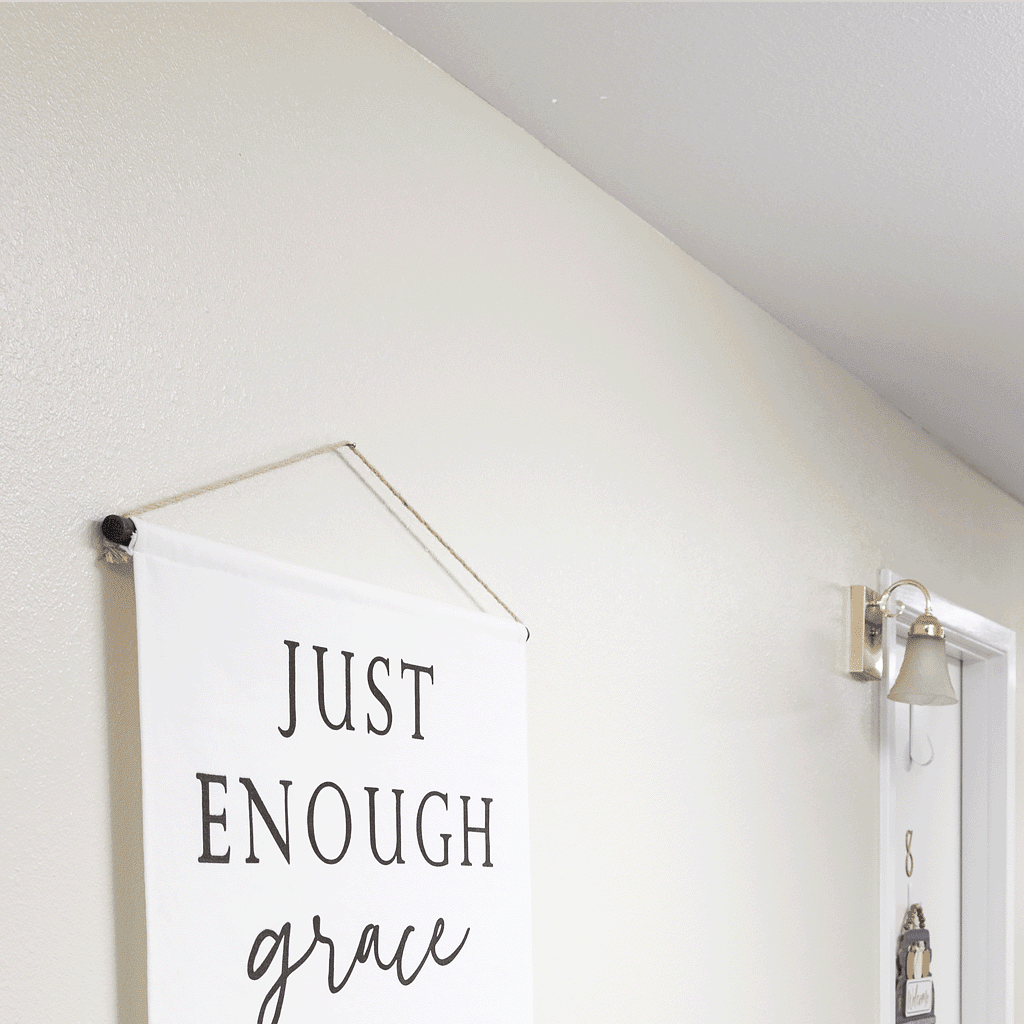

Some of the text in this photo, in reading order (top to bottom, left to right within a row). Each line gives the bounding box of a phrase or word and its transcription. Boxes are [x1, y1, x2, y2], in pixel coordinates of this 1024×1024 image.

[276, 639, 434, 741] JUST
[195, 772, 494, 868] ENOUGH
[905, 829, 914, 878] 8
